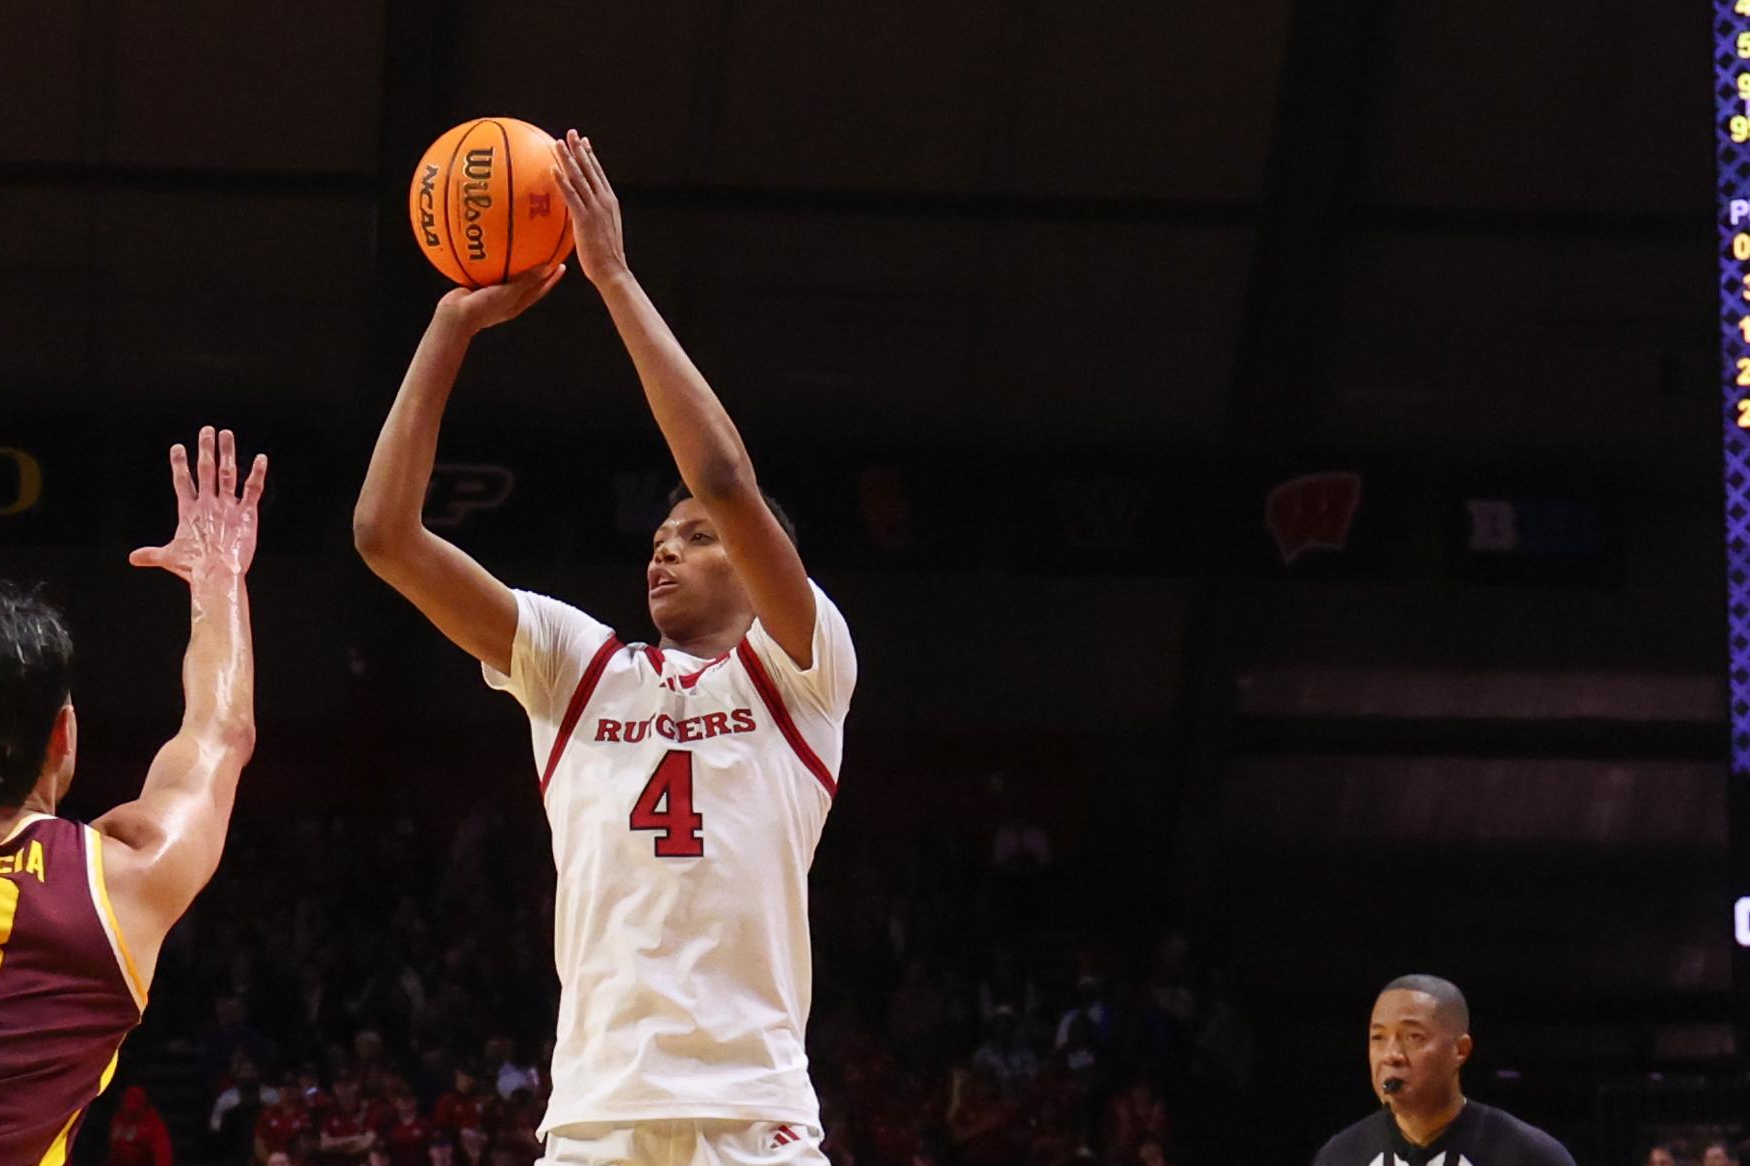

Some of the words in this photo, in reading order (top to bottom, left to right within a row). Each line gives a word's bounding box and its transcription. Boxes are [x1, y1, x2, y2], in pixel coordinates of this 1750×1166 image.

[419, 164, 441, 247] NCAA
[462, 146, 495, 262] Wilson
[629, 749, 705, 858] 4
